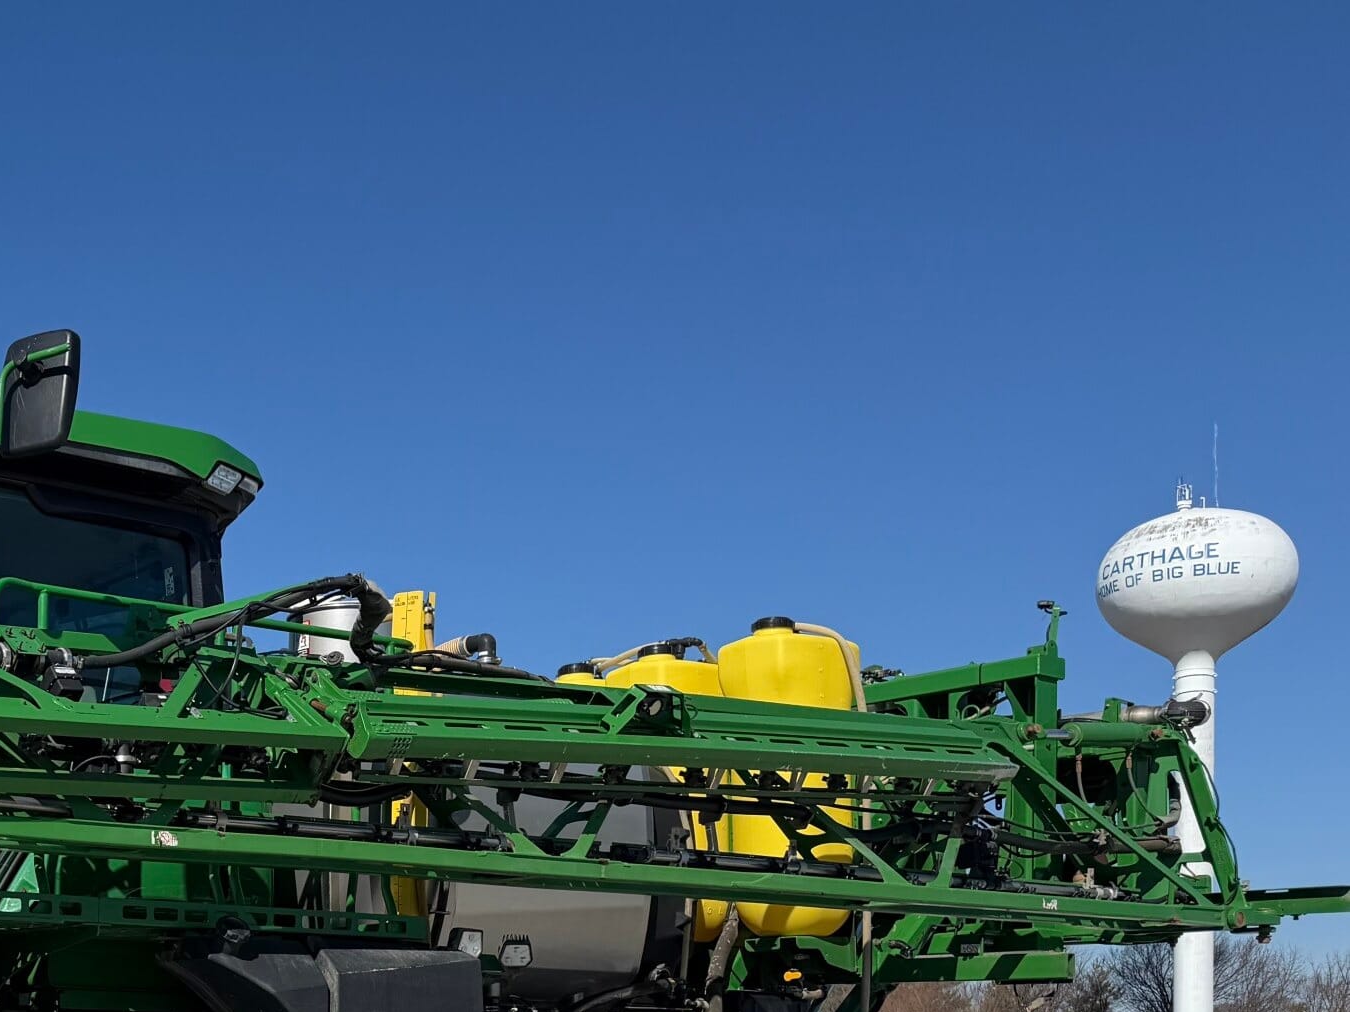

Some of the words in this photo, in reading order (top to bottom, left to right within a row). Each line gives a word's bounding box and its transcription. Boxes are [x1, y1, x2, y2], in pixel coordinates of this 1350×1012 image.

[1098, 580, 1120, 599] HOME
[1125, 572, 1143, 588] OF
[1152, 566, 1184, 582] BIG
[1193, 561, 1241, 577] BLUE
[1102, 542, 1219, 580] CARTHAGE
